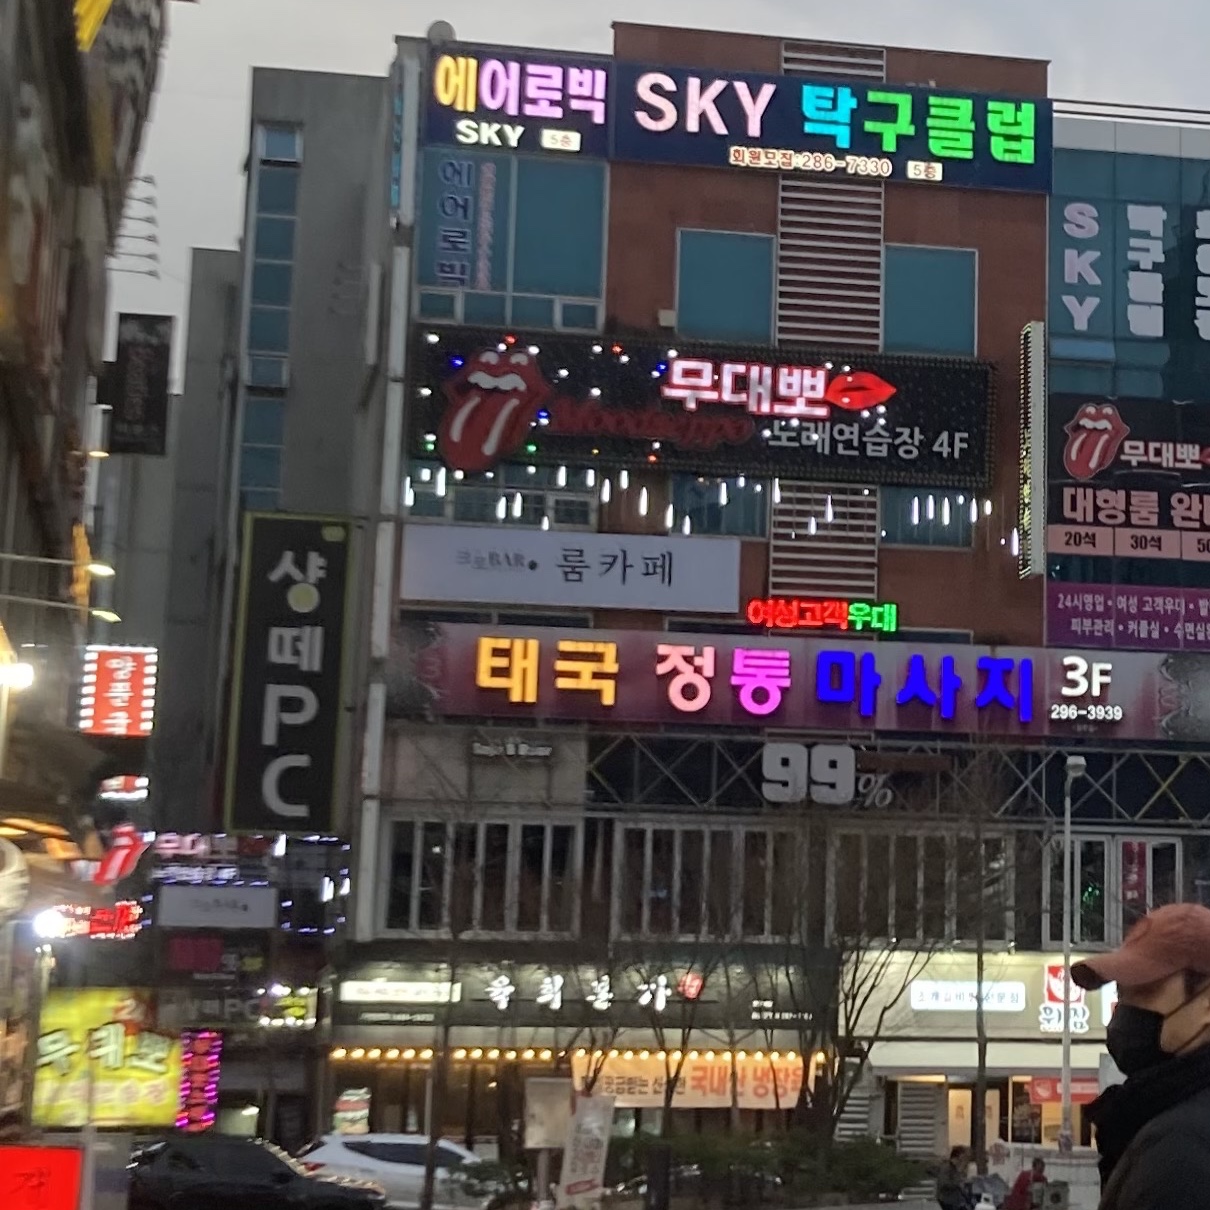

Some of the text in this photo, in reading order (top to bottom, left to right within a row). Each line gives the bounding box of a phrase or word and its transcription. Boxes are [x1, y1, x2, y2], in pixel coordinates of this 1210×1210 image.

[434, 54, 607, 125] 에어로빅
[455, 119, 525, 148] SKY
[634, 72, 1036, 166] SKY 탁구클럽
[437, 159, 474, 287] 에어로빅
[1062, 203, 1102, 331] SKY
[660, 356, 830, 418] 무대뽀
[768, 418, 925, 460] 노래연습장
[931, 431, 970, 460] 4F
[1120, 440, 1202, 471] 무대뽀
[1062, 486, 1159, 526] 대형룸
[1064, 530, 1097, 548] 20석
[1130, 534, 1162, 551] 30석
[556, 548, 674, 587] 룸카페
[747, 599, 898, 632] 여성고객우대
[475, 636, 1113, 724] 태국 정통 마사지 3F
[1050, 703, 1123, 721] 296-3939
